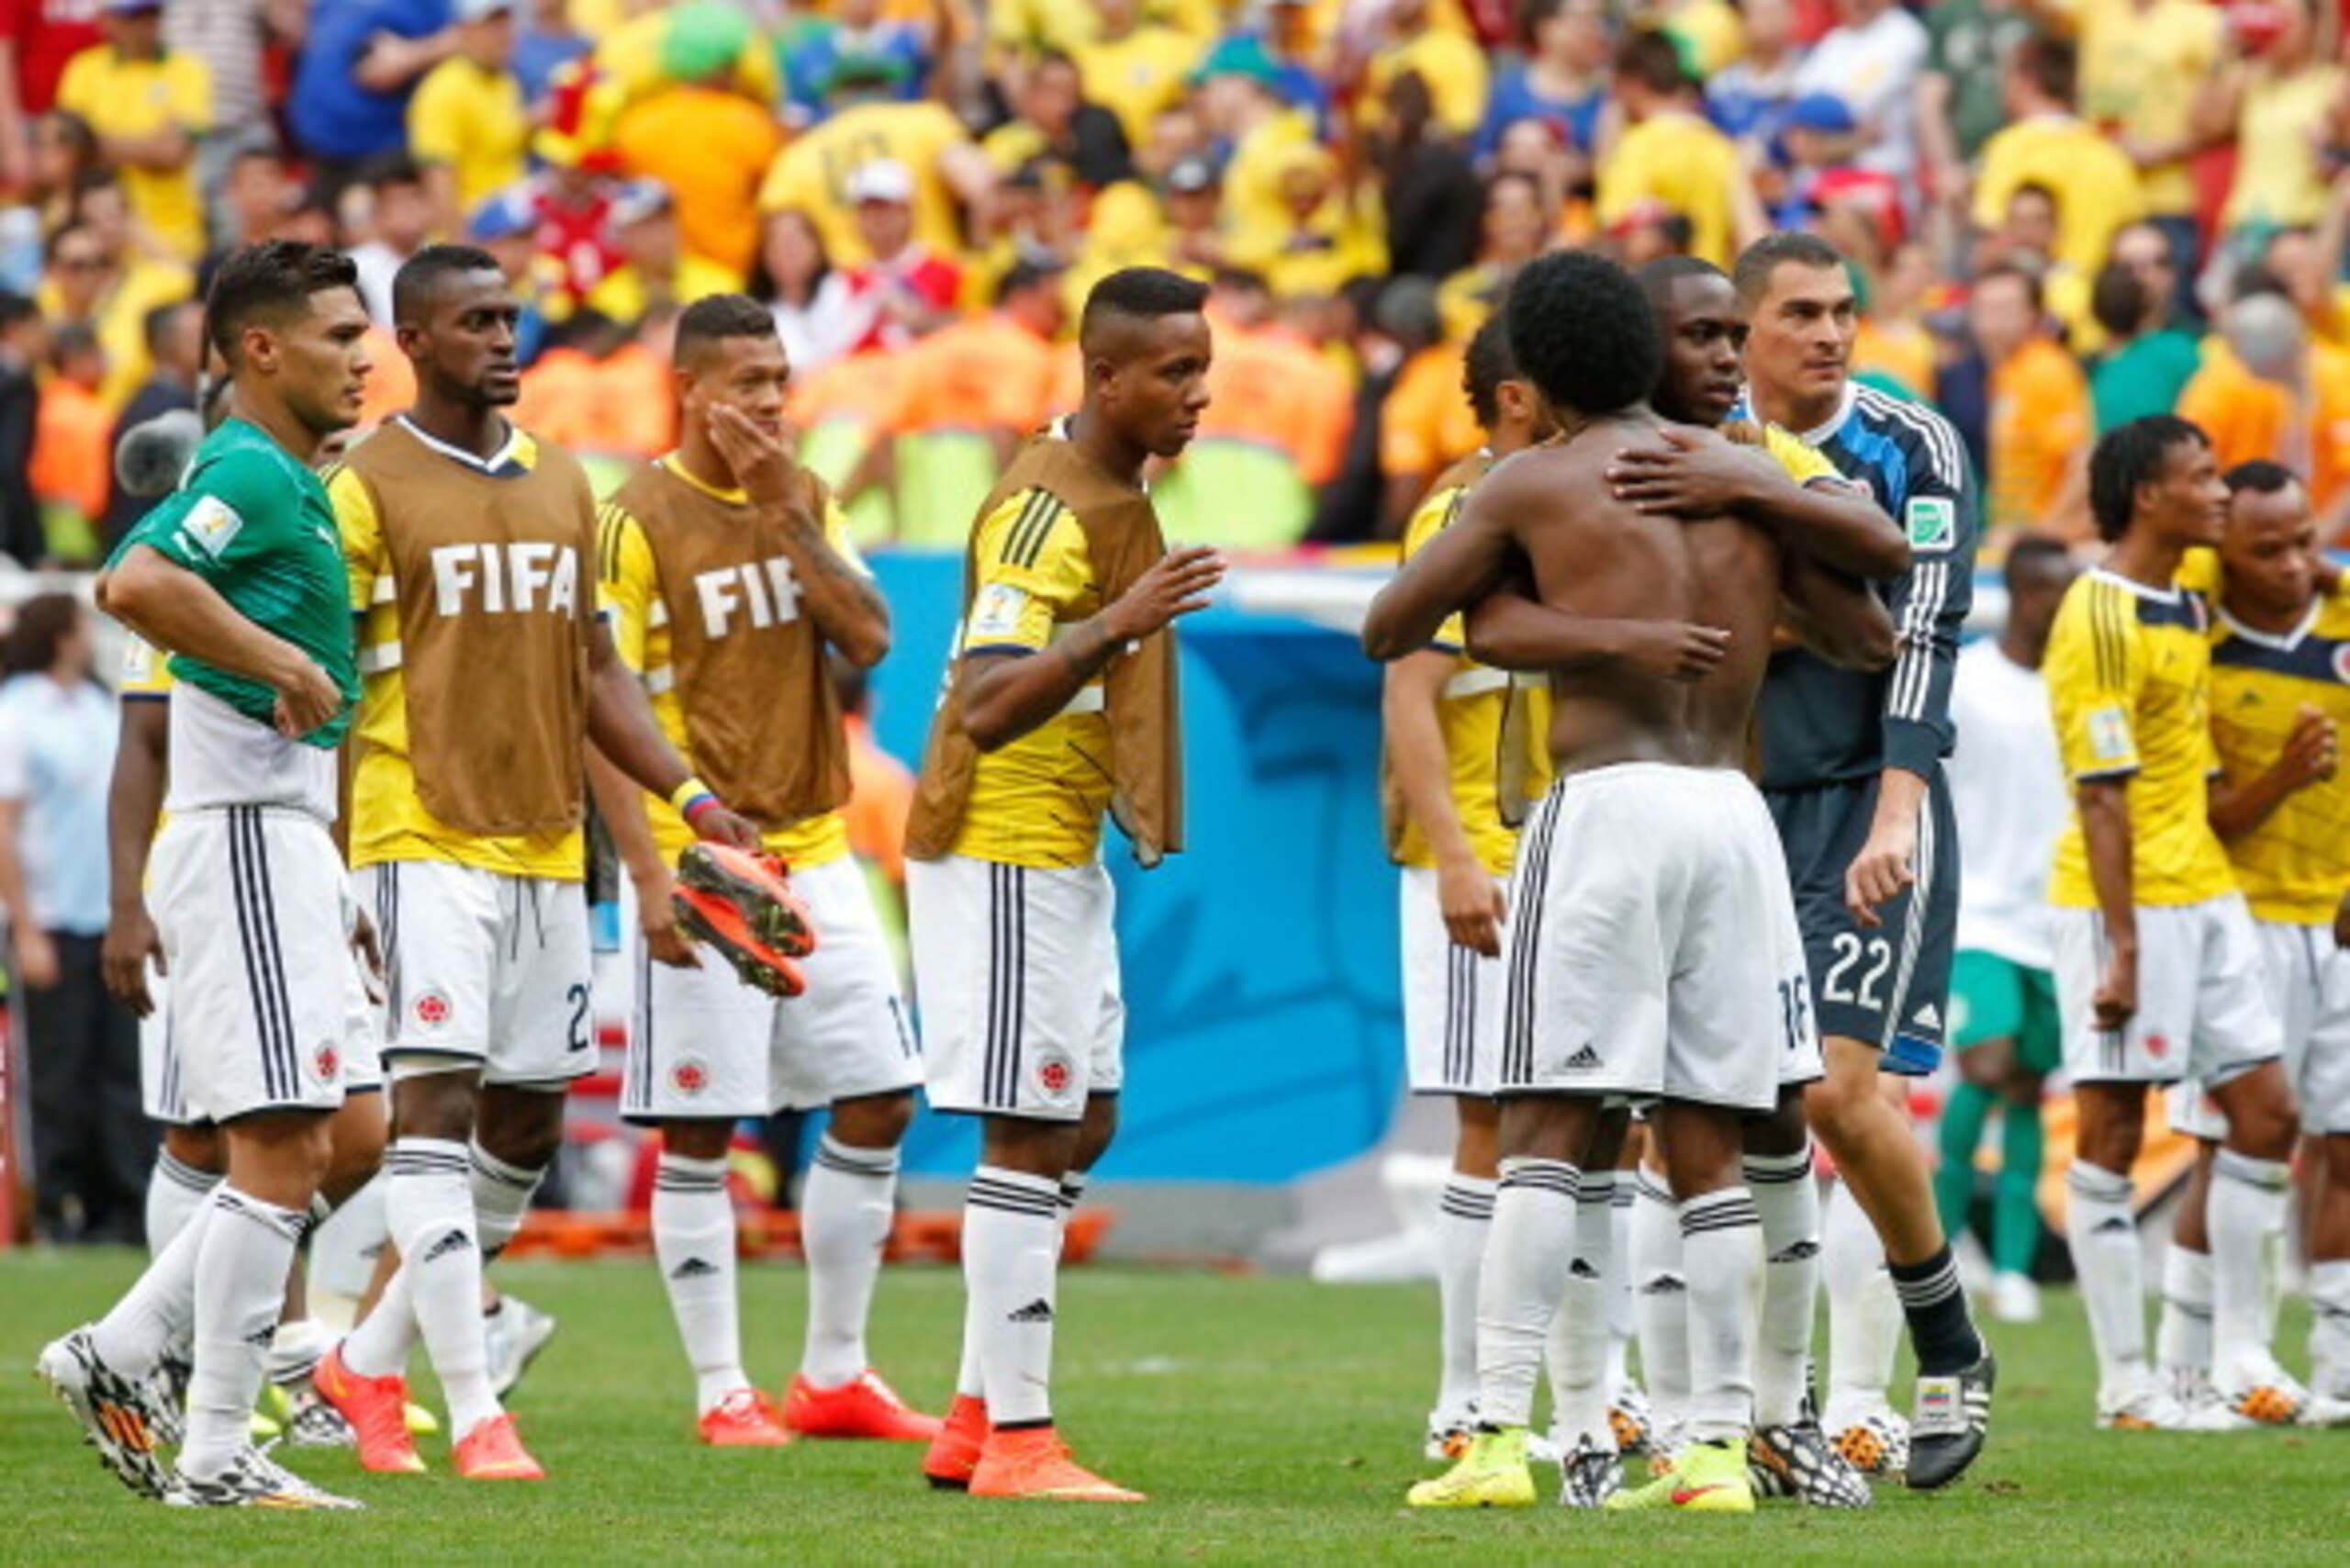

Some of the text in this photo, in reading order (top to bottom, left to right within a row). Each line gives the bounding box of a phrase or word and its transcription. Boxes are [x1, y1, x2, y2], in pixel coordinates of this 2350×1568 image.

[431, 542, 577, 621] FIFA
[694, 555, 804, 639] FIF
[1822, 932, 1891, 1010] 22
[566, 980, 592, 1053] 2
